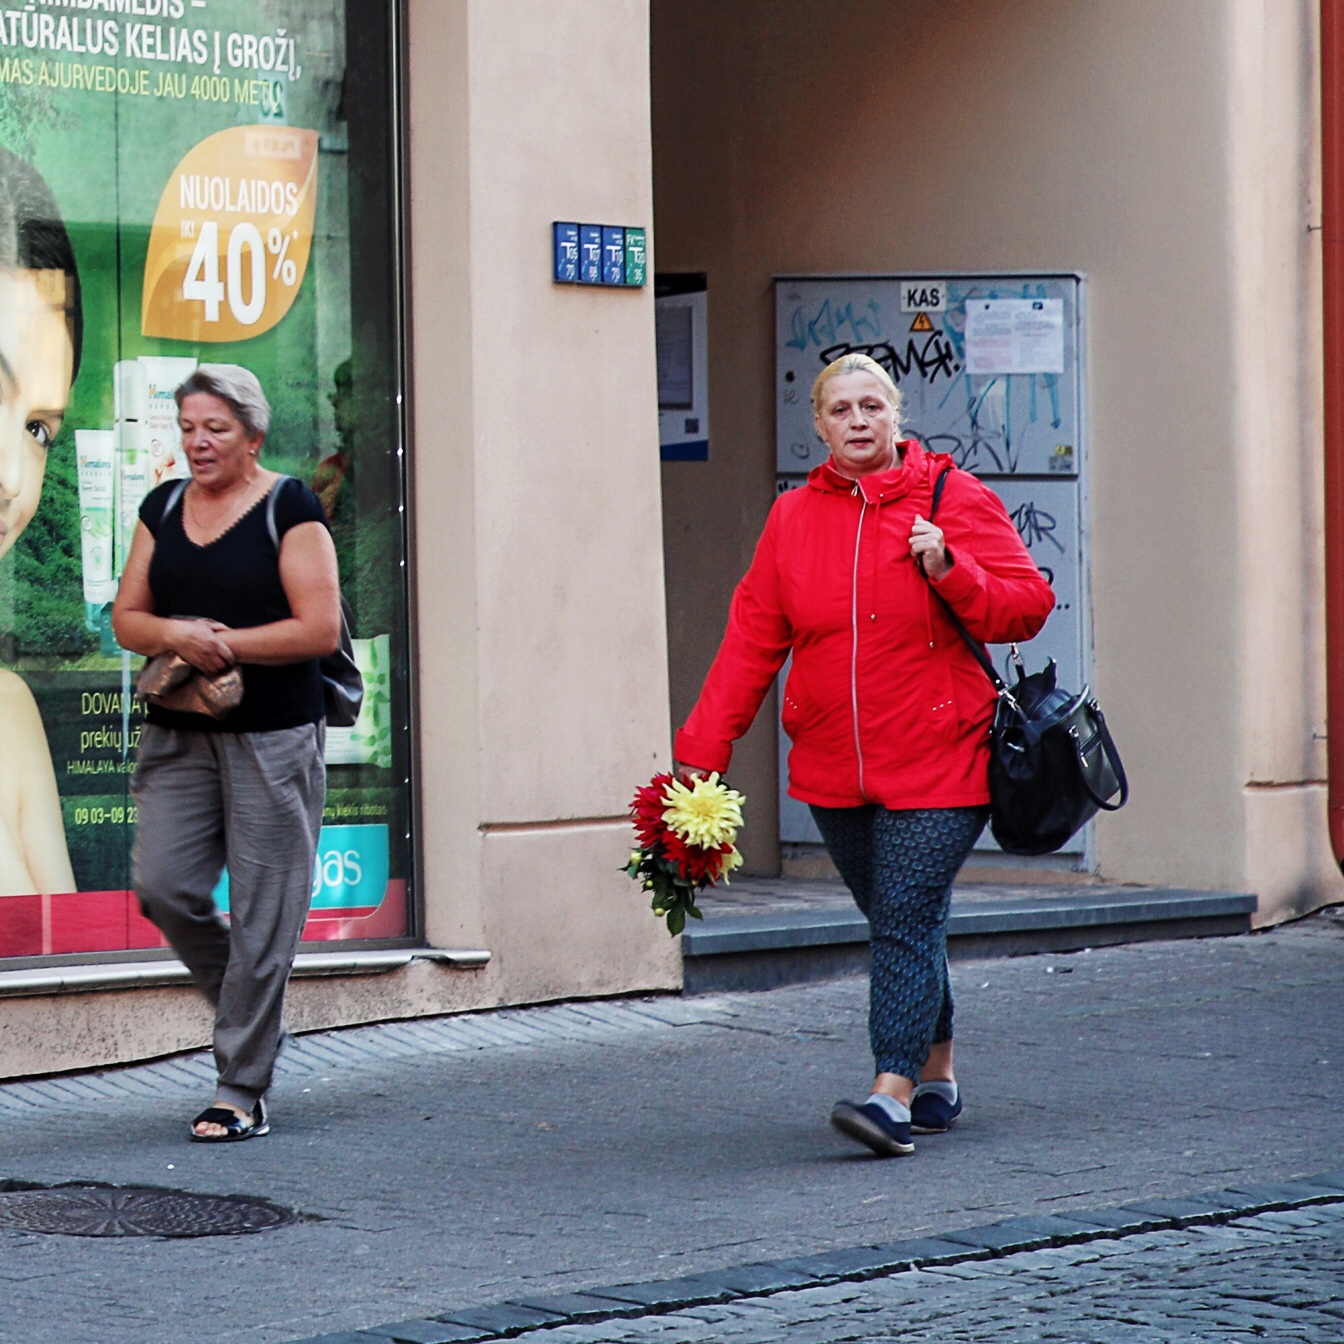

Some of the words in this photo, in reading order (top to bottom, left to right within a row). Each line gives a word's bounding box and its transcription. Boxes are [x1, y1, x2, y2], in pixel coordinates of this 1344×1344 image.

[126, 22, 209, 66] KELIAS
[213, 31, 221, 74] Į
[226, 28, 302, 81] GROŽĮ,
[38, 58, 151, 94] AJURVEDOJE
[153, 73, 187, 99] JAU
[190, 76, 231, 103] 4000
[234, 80, 283, 112] METŲ
[179, 173, 299, 217] NUOLAIDOS
[180, 219, 195, 239] IKI
[906, 289, 940, 308] KAS
[80, 725, 122, 753] prekių
[66, 759, 115, 774] HIMALAYA
[75, 807, 88, 825] 09
